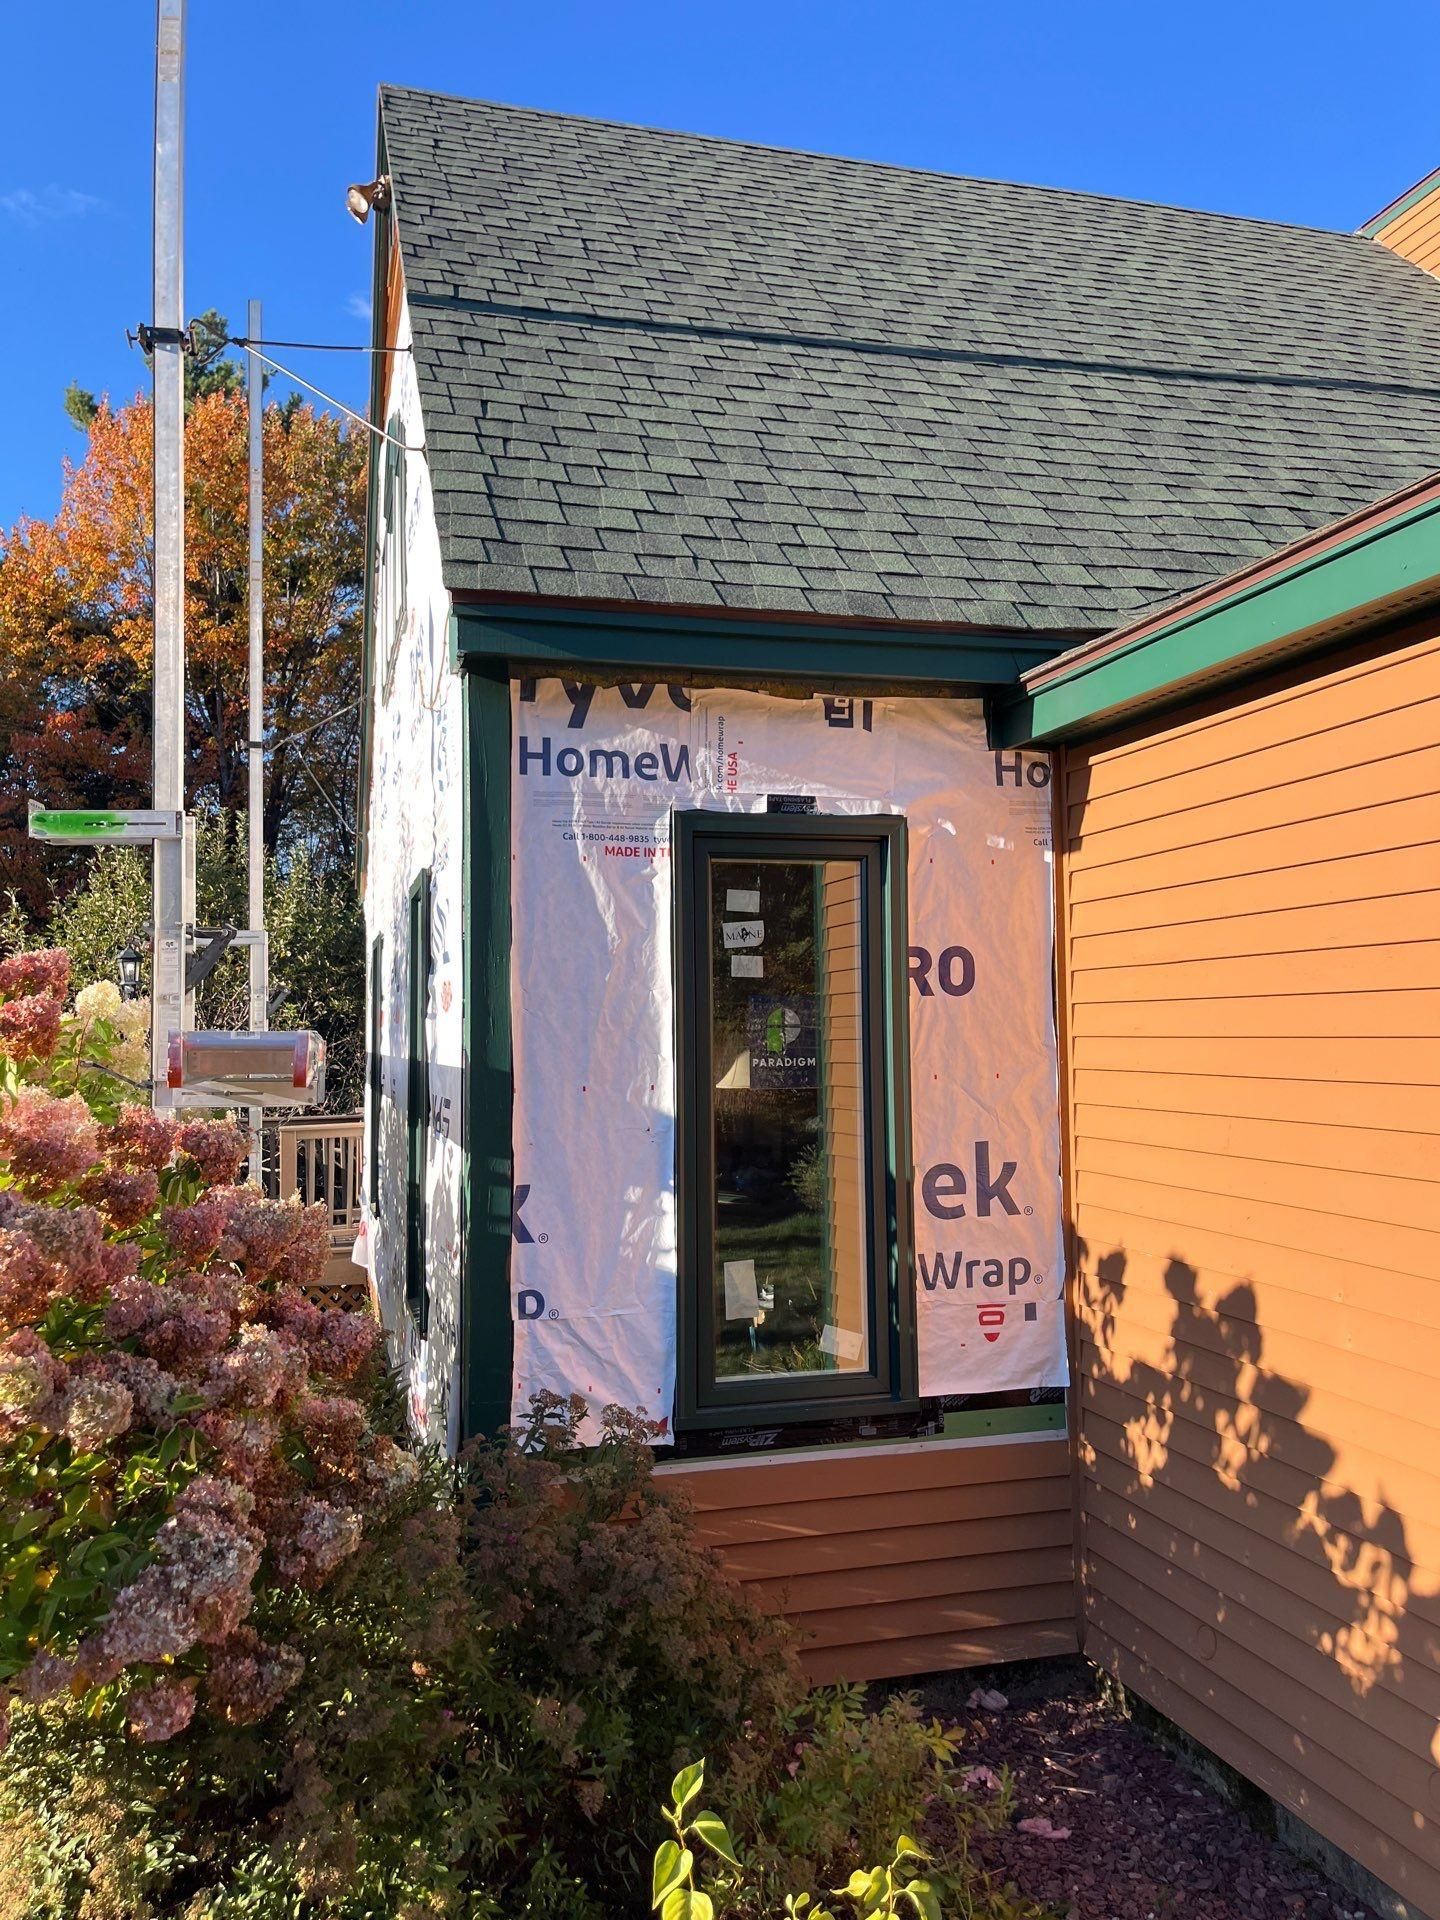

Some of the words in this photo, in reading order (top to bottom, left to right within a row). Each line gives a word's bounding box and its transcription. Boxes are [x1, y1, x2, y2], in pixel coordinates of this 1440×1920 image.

[727, 752, 738, 776] USA
[994, 751, 1050, 788] Ho
[562, 832, 579, 841] Call
[581, 833, 650, 843] 1-800-448-9835
[1033, 838, 1048, 847] Call
[605, 845, 640, 858] MADE
[644, 847, 656, 858] IN
[909, 946, 976, 997] RO
[752, 1057, 816, 1067] PARADIGM
